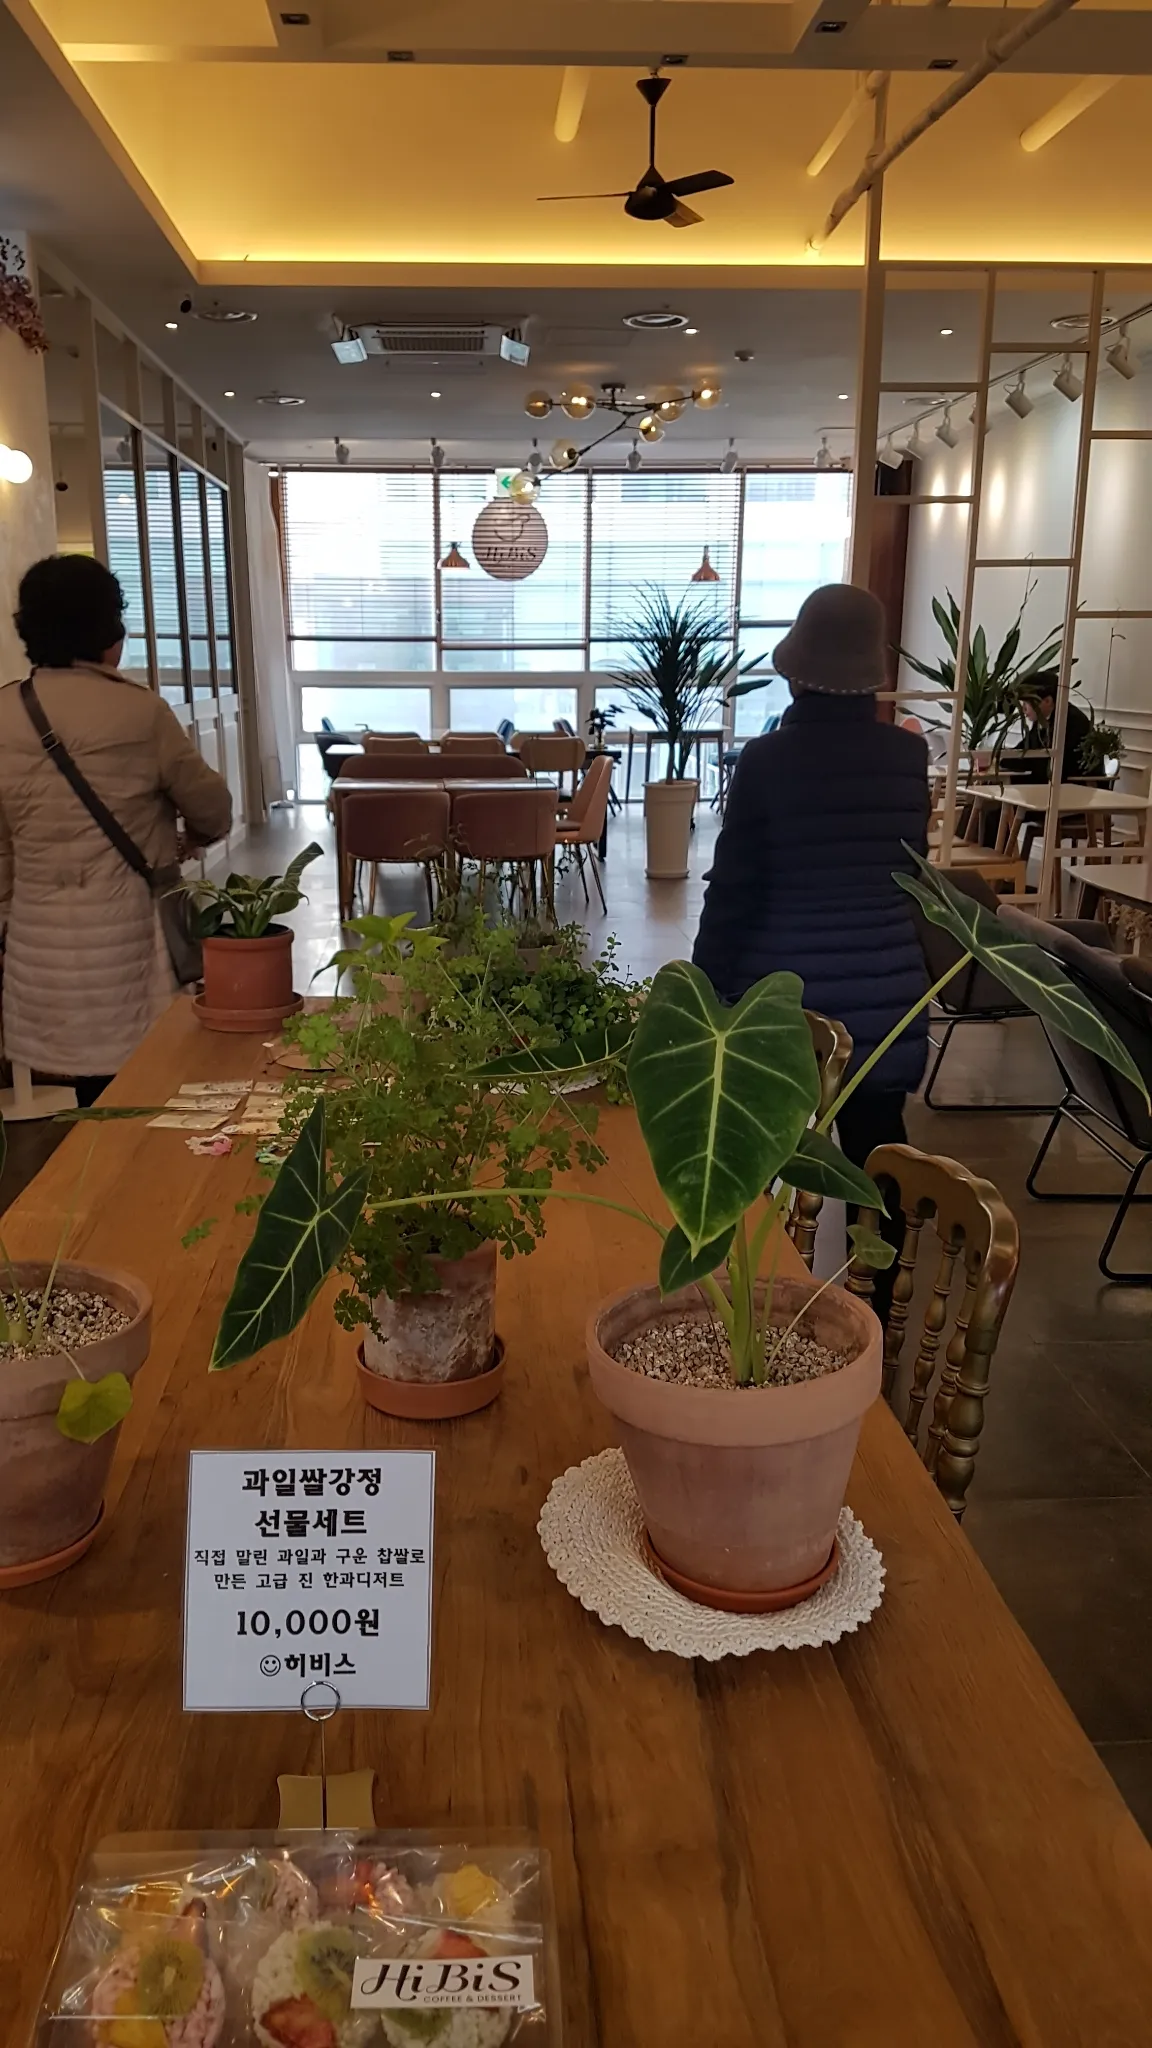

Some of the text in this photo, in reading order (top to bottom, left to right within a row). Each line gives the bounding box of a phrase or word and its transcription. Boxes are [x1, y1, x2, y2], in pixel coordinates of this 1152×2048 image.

[241, 1467, 382, 1497] 과일쌀강정
[254, 1508, 368, 1538] 선물세트
[193, 1547, 426, 1567] 직접 말린 과일과 구운 찹쌀로
[214, 1571, 405, 1590] 만든 고급 진 한과디저트
[236, 1608, 380, 1639] 10,000원
[283, 1652, 357, 1678] 히비스
[423, 1993, 522, 2004] COFFEE & DESSERT
